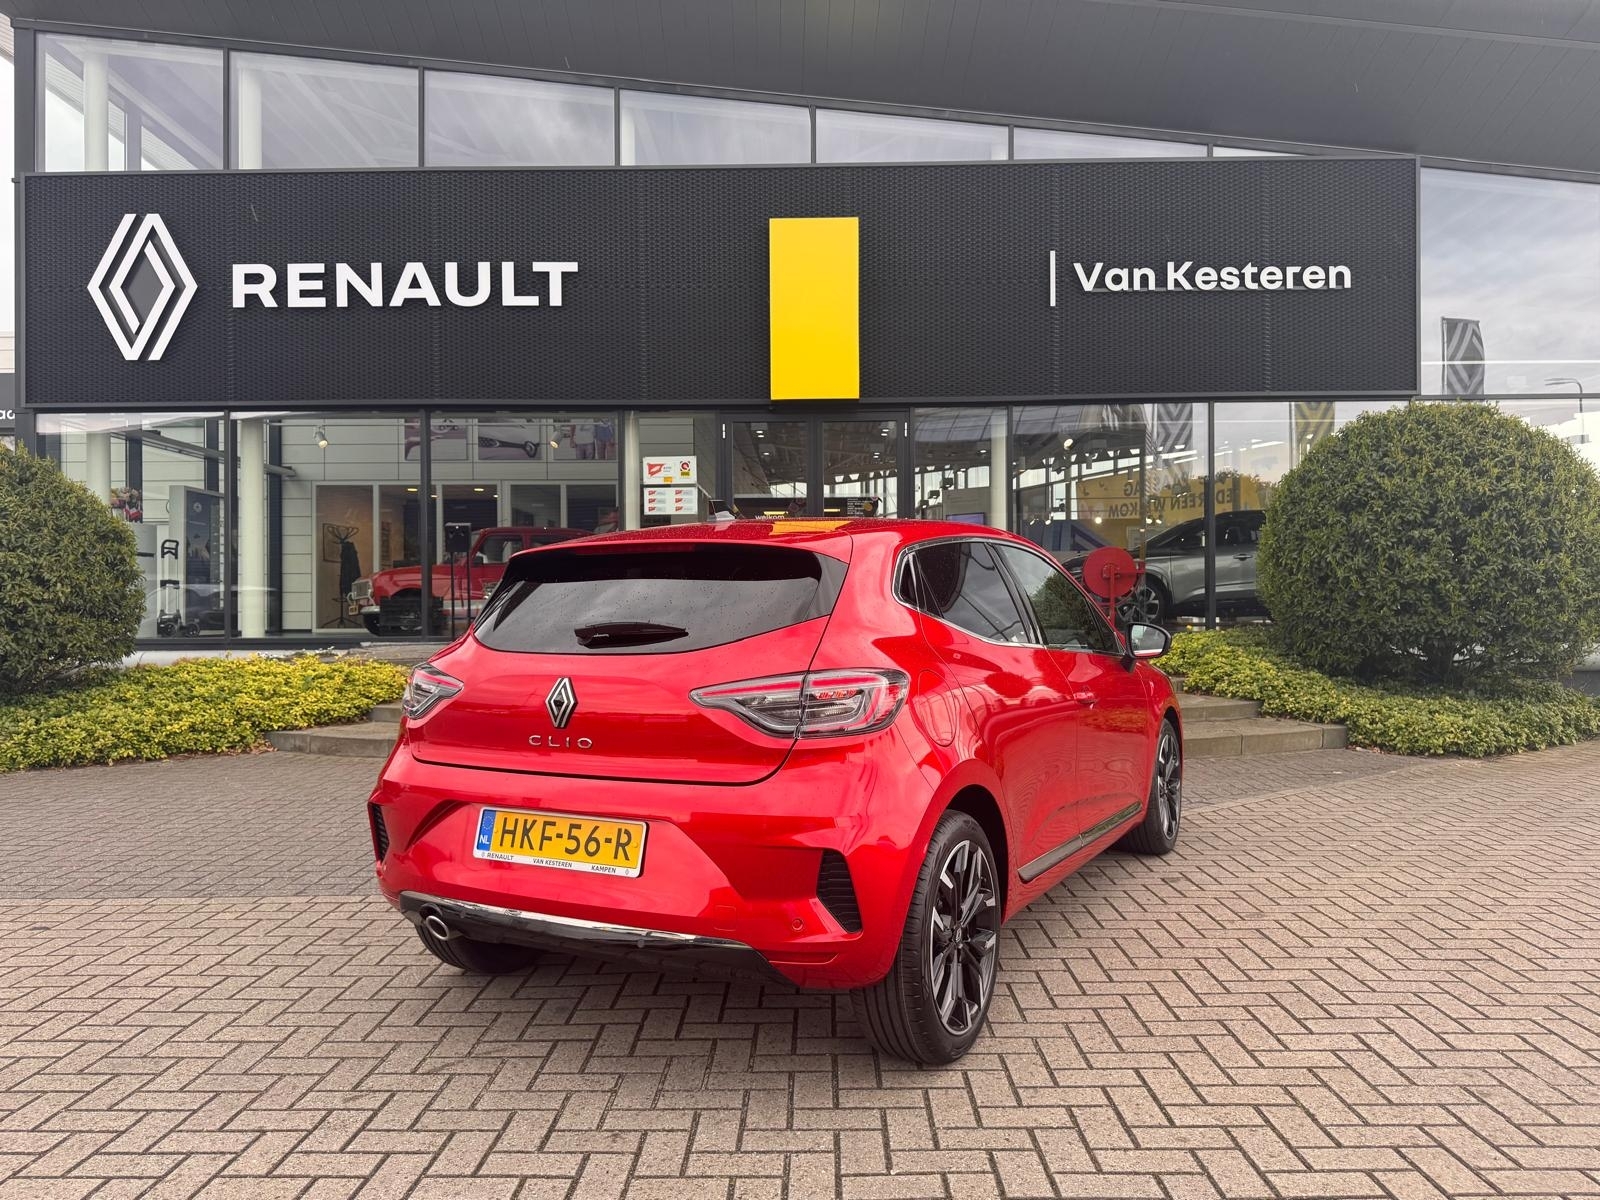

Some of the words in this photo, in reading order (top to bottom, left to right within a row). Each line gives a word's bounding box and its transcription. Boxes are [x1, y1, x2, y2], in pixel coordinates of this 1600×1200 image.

[232, 261, 579, 308] RENAULT
[1073, 263, 1156, 292] Van
[1167, 261, 1352, 291] Kesteren
[528, 735, 593, 749] CLIO
[479, 834, 490, 845] NL
[499, 816, 632, 861] HKF-56-R
[486, 851, 514, 862] RENAULT
[532, 857, 544, 866] VAN
[544, 859, 573, 869] KESTEREN
[591, 865, 617, 875] KAMPEN
